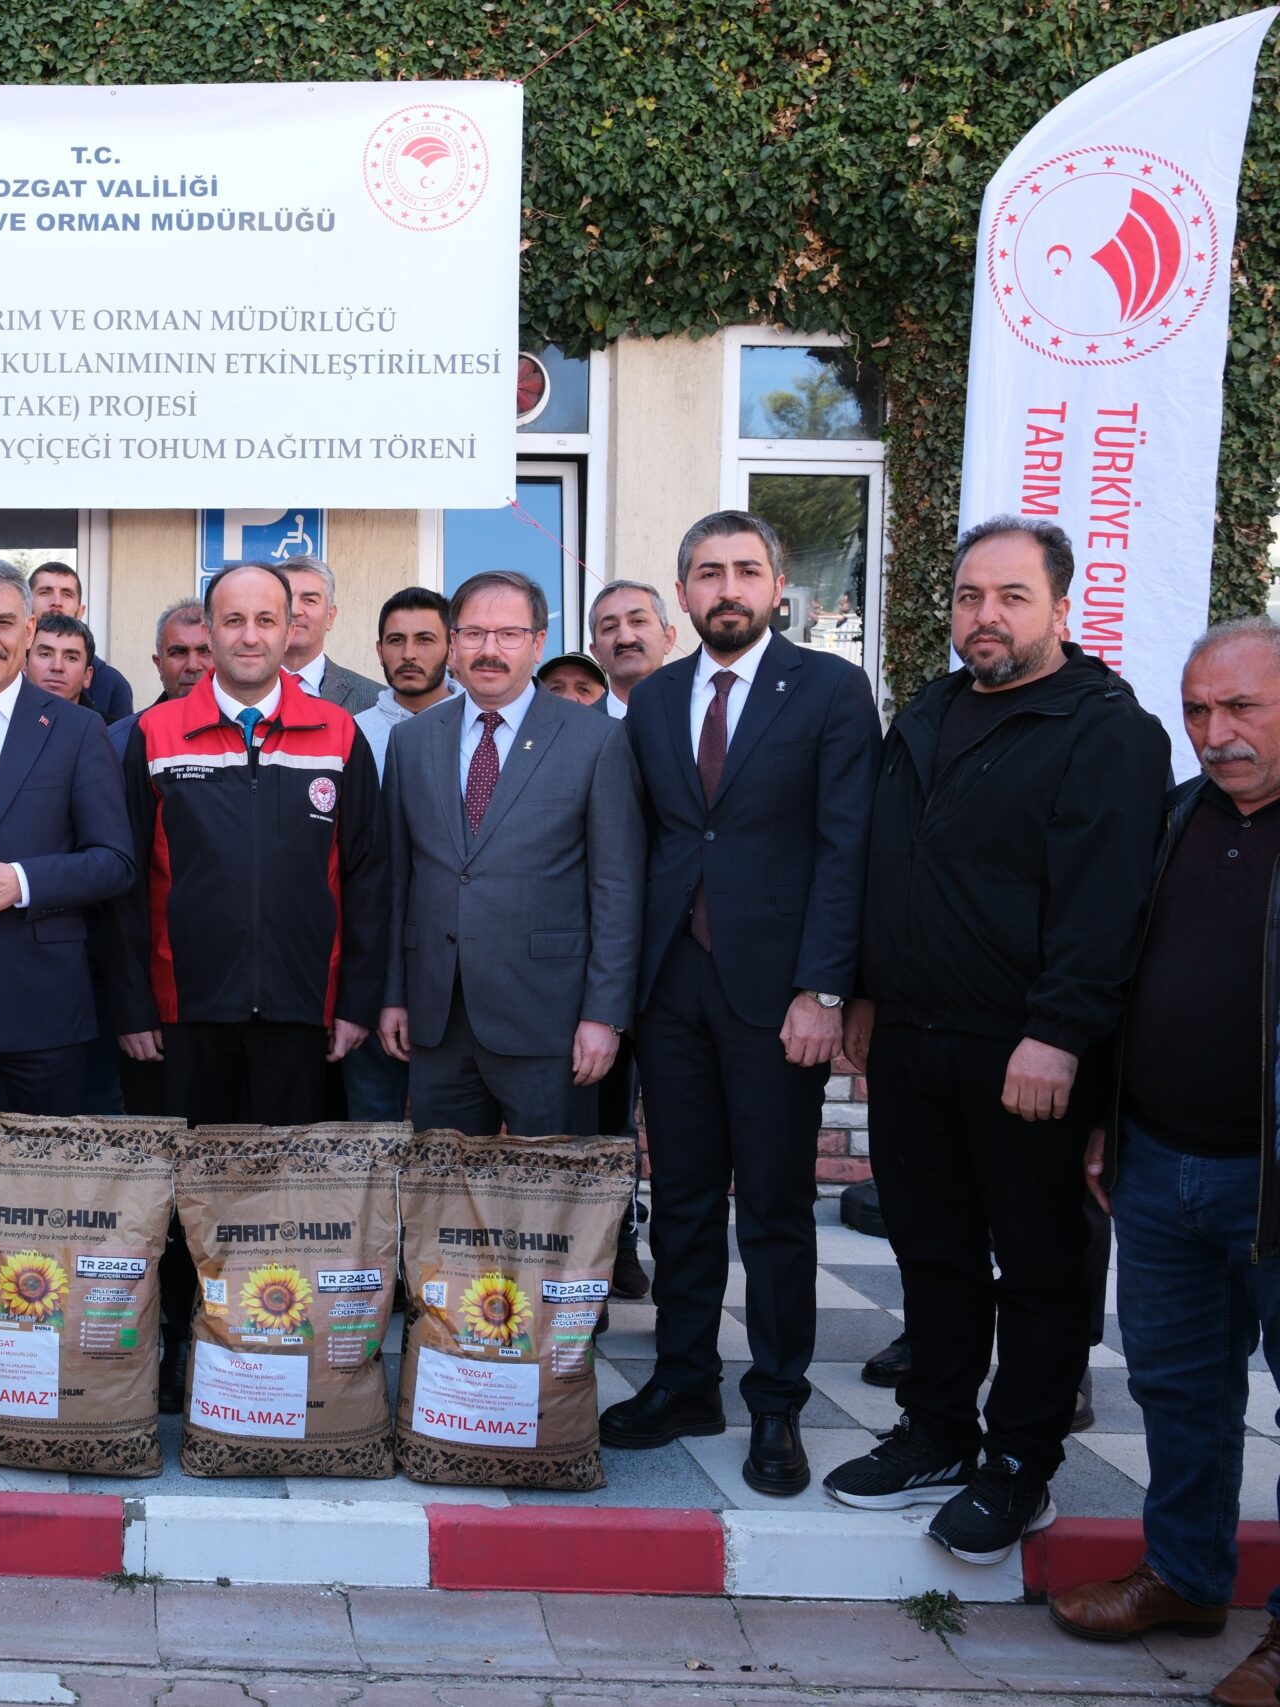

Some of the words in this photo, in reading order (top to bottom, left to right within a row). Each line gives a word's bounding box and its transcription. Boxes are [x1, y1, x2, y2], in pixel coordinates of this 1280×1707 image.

[71, 147, 120, 164] T.C.
[95, 175, 218, 198] VALİLİĞİ
[35, 212, 141, 232] ORMAN
[151, 206, 335, 233] MÜDÜRLÜĞÜ
[49, 309, 85, 331] VE
[93, 309, 202, 331] ORMAN
[210, 305, 396, 332] MÜDÜRLÜĞÜ
[1, 352, 216, 374] KULLANIMININ
[225, 348, 502, 380] ETKİNLEŞTİRİLMESİ
[88, 390, 197, 422] PROJESİ
[119, 438, 227, 459] TOHUM
[235, 433, 362, 459] DAĞITIM
[370, 433, 477, 459] TÖRENİ
[1021, 401, 1067, 515] TARIM
[1088, 403, 1146, 549] TÜRKİYE
[4, 1230, 36, 1240] everything
[237, 1247, 269, 1256] everything
[441, 1249, 463, 1258] Forget
[464, 1253, 494, 1262] everything
[496, 1255, 507, 1263] you
[80, 1260, 95, 1269] TR
[98, 1261, 128, 1271] 2242
[130, 1263, 144, 1271] CL
[321, 1275, 336, 1284] TR
[339, 1274, 365, 1283] 2242
[367, 1273, 379, 1282] CL
[545, 1285, 558, 1295] TR
[560, 1284, 590, 1295] 2242
[593, 1284, 607, 1293] CL
[230, 1360, 263, 1371] YOZGAT
[457, 1366, 493, 1379] YOZGAT
[195, 1398, 304, 1425] "SATILAMAZ"
[418, 1406, 536, 1435] "SATILAMAZ"
